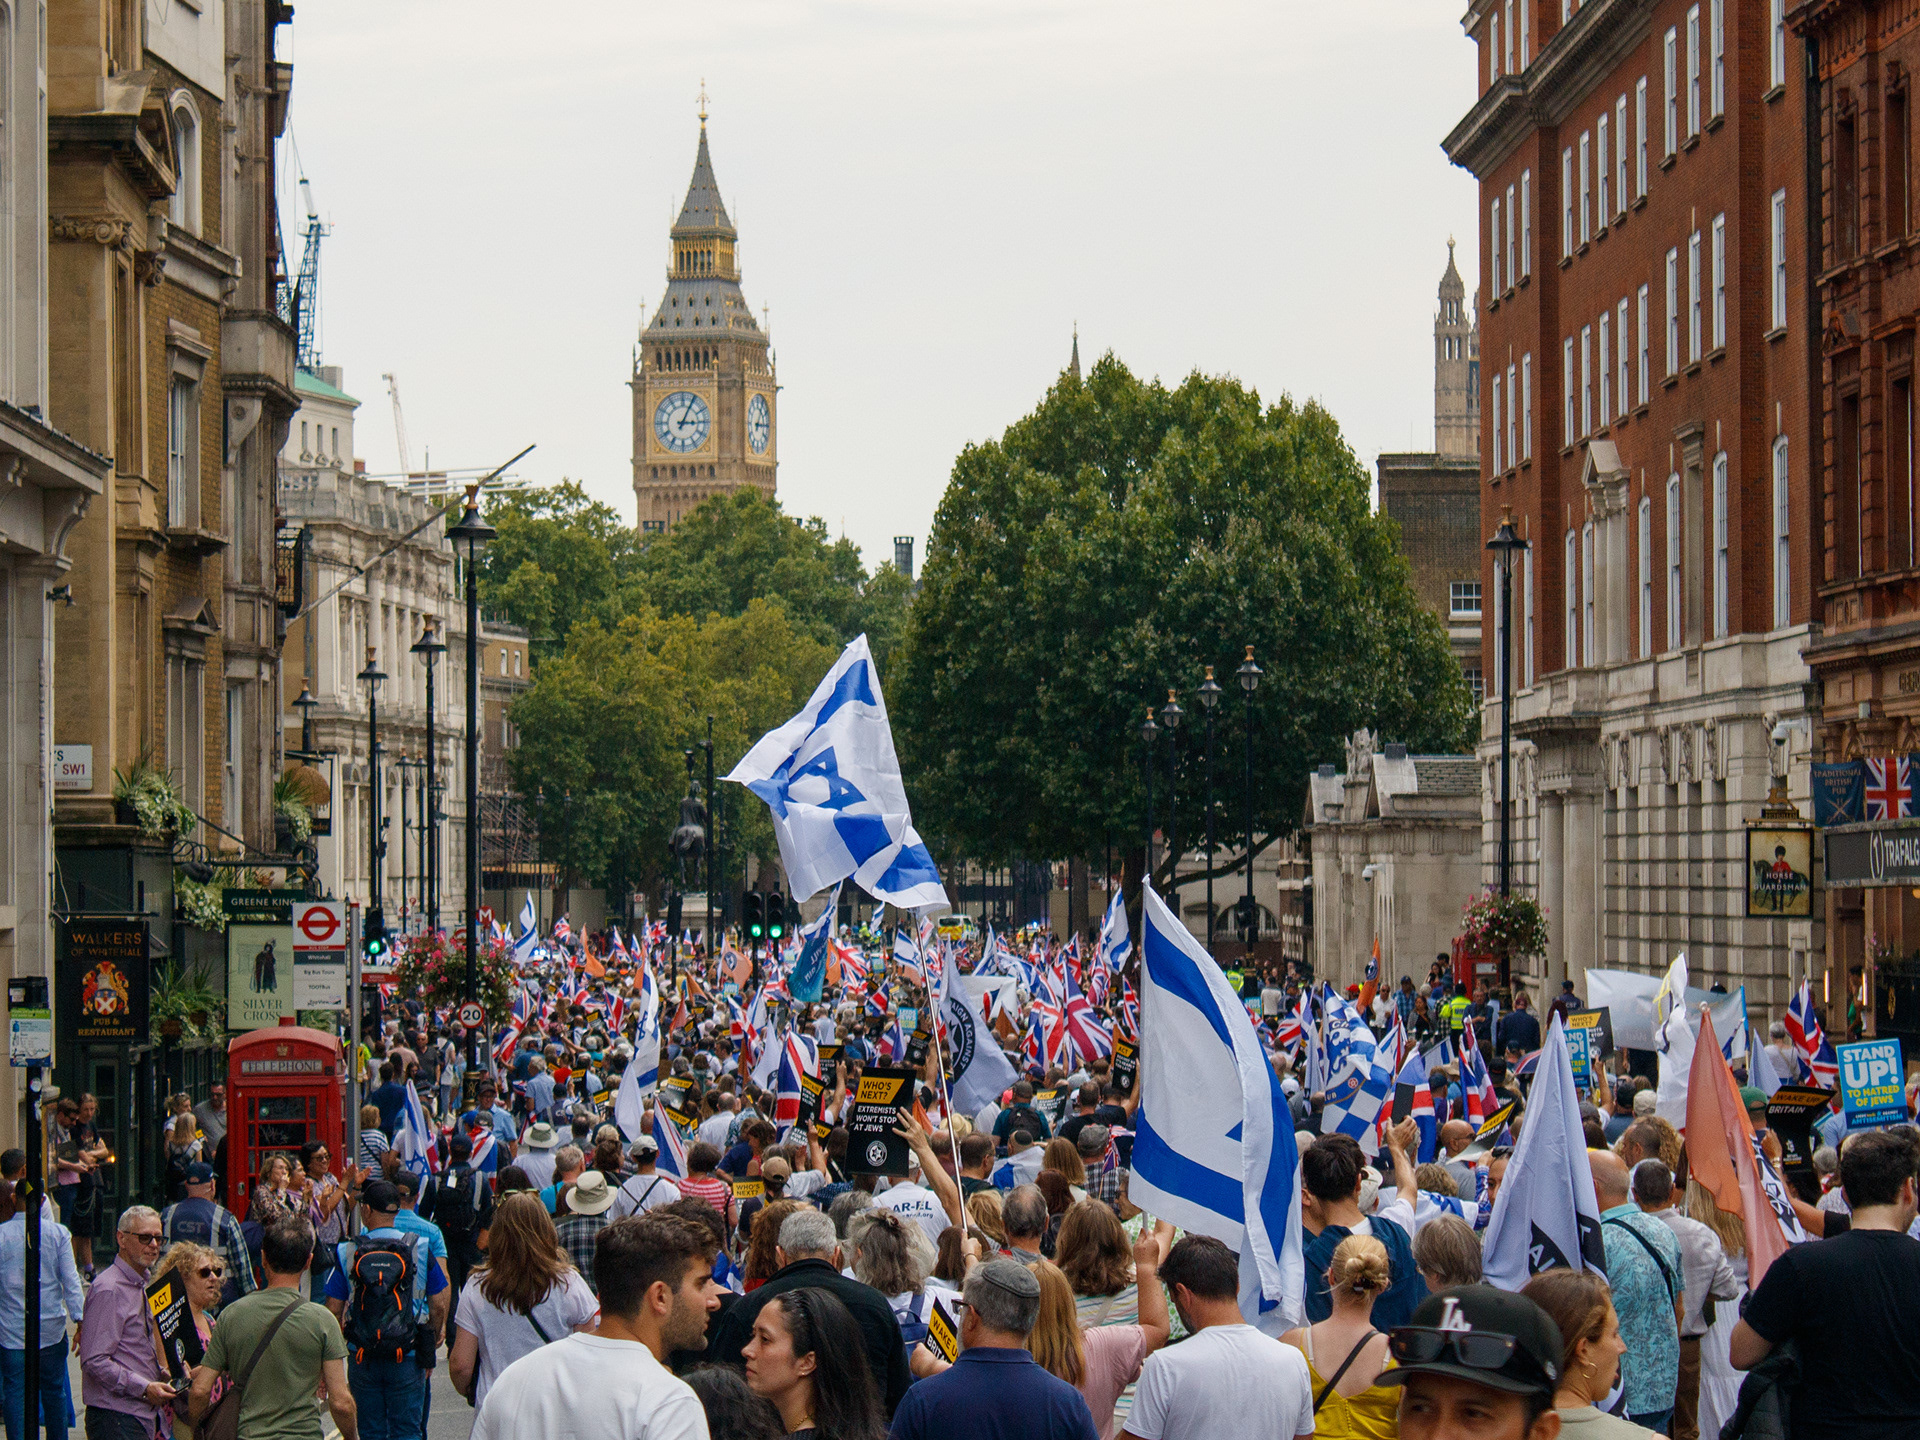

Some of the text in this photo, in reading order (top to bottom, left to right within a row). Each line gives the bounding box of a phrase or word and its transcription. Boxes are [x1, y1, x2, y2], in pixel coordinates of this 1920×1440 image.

[62, 763, 85, 775] SW1
[1814, 769, 1861, 778] TRADITIONAL
[1825, 778, 1852, 786] BRITISH
[1832, 787, 1846, 795] PUB
[1753, 883, 1806, 891] GUARDSMAN
[231, 898, 269, 906] GREENE
[479, 909, 492, 921] M
[72, 932, 142, 945] WALKERS
[70, 947, 142, 957] OF WHITEHALL
[243, 1000, 282, 1010] SILVER
[243, 1011, 281, 1021] CROSS
[462, 1010, 481, 1021] 20
[93, 1018, 111, 1026] PUB
[78, 1028, 136, 1036] RESTAURANT
[960, 1023, 973, 1070] AGAINST
[1118, 1046, 1128, 1054] ACT
[1843, 1046, 1896, 1063] STAND
[248, 1060, 320, 1071] TELEPHONE
[1844, 1057, 1899, 1088] UP!
[863, 1080, 892, 1090] WHO'S
[860, 1090, 888, 1100] NEXT?
[1847, 1085, 1900, 1098] TO HATRED
[1856, 1095, 1894, 1108] OF JEWS
[858, 1106, 897, 1115] EXTREMISTS
[1768, 1106, 1806, 1114] BRITAIN
[856, 1114, 898, 1124] WON'T STOP
[1482, 1116, 1500, 1130] WAKE
[1852, 1112, 1904, 1125] ANTISEMITISM
[864, 1124, 884, 1132] JEWS
[177, 1221, 205, 1234] CST
[154, 1292, 168, 1310] ACT
[158, 1296, 186, 1323] AGAINST HATE
[1440, 1297, 1472, 1332] LA
[160, 1308, 182, 1332] IT'S NEARLY
[170, 1320, 180, 1334] LATE
[933, 1316, 952, 1350] WAKE
